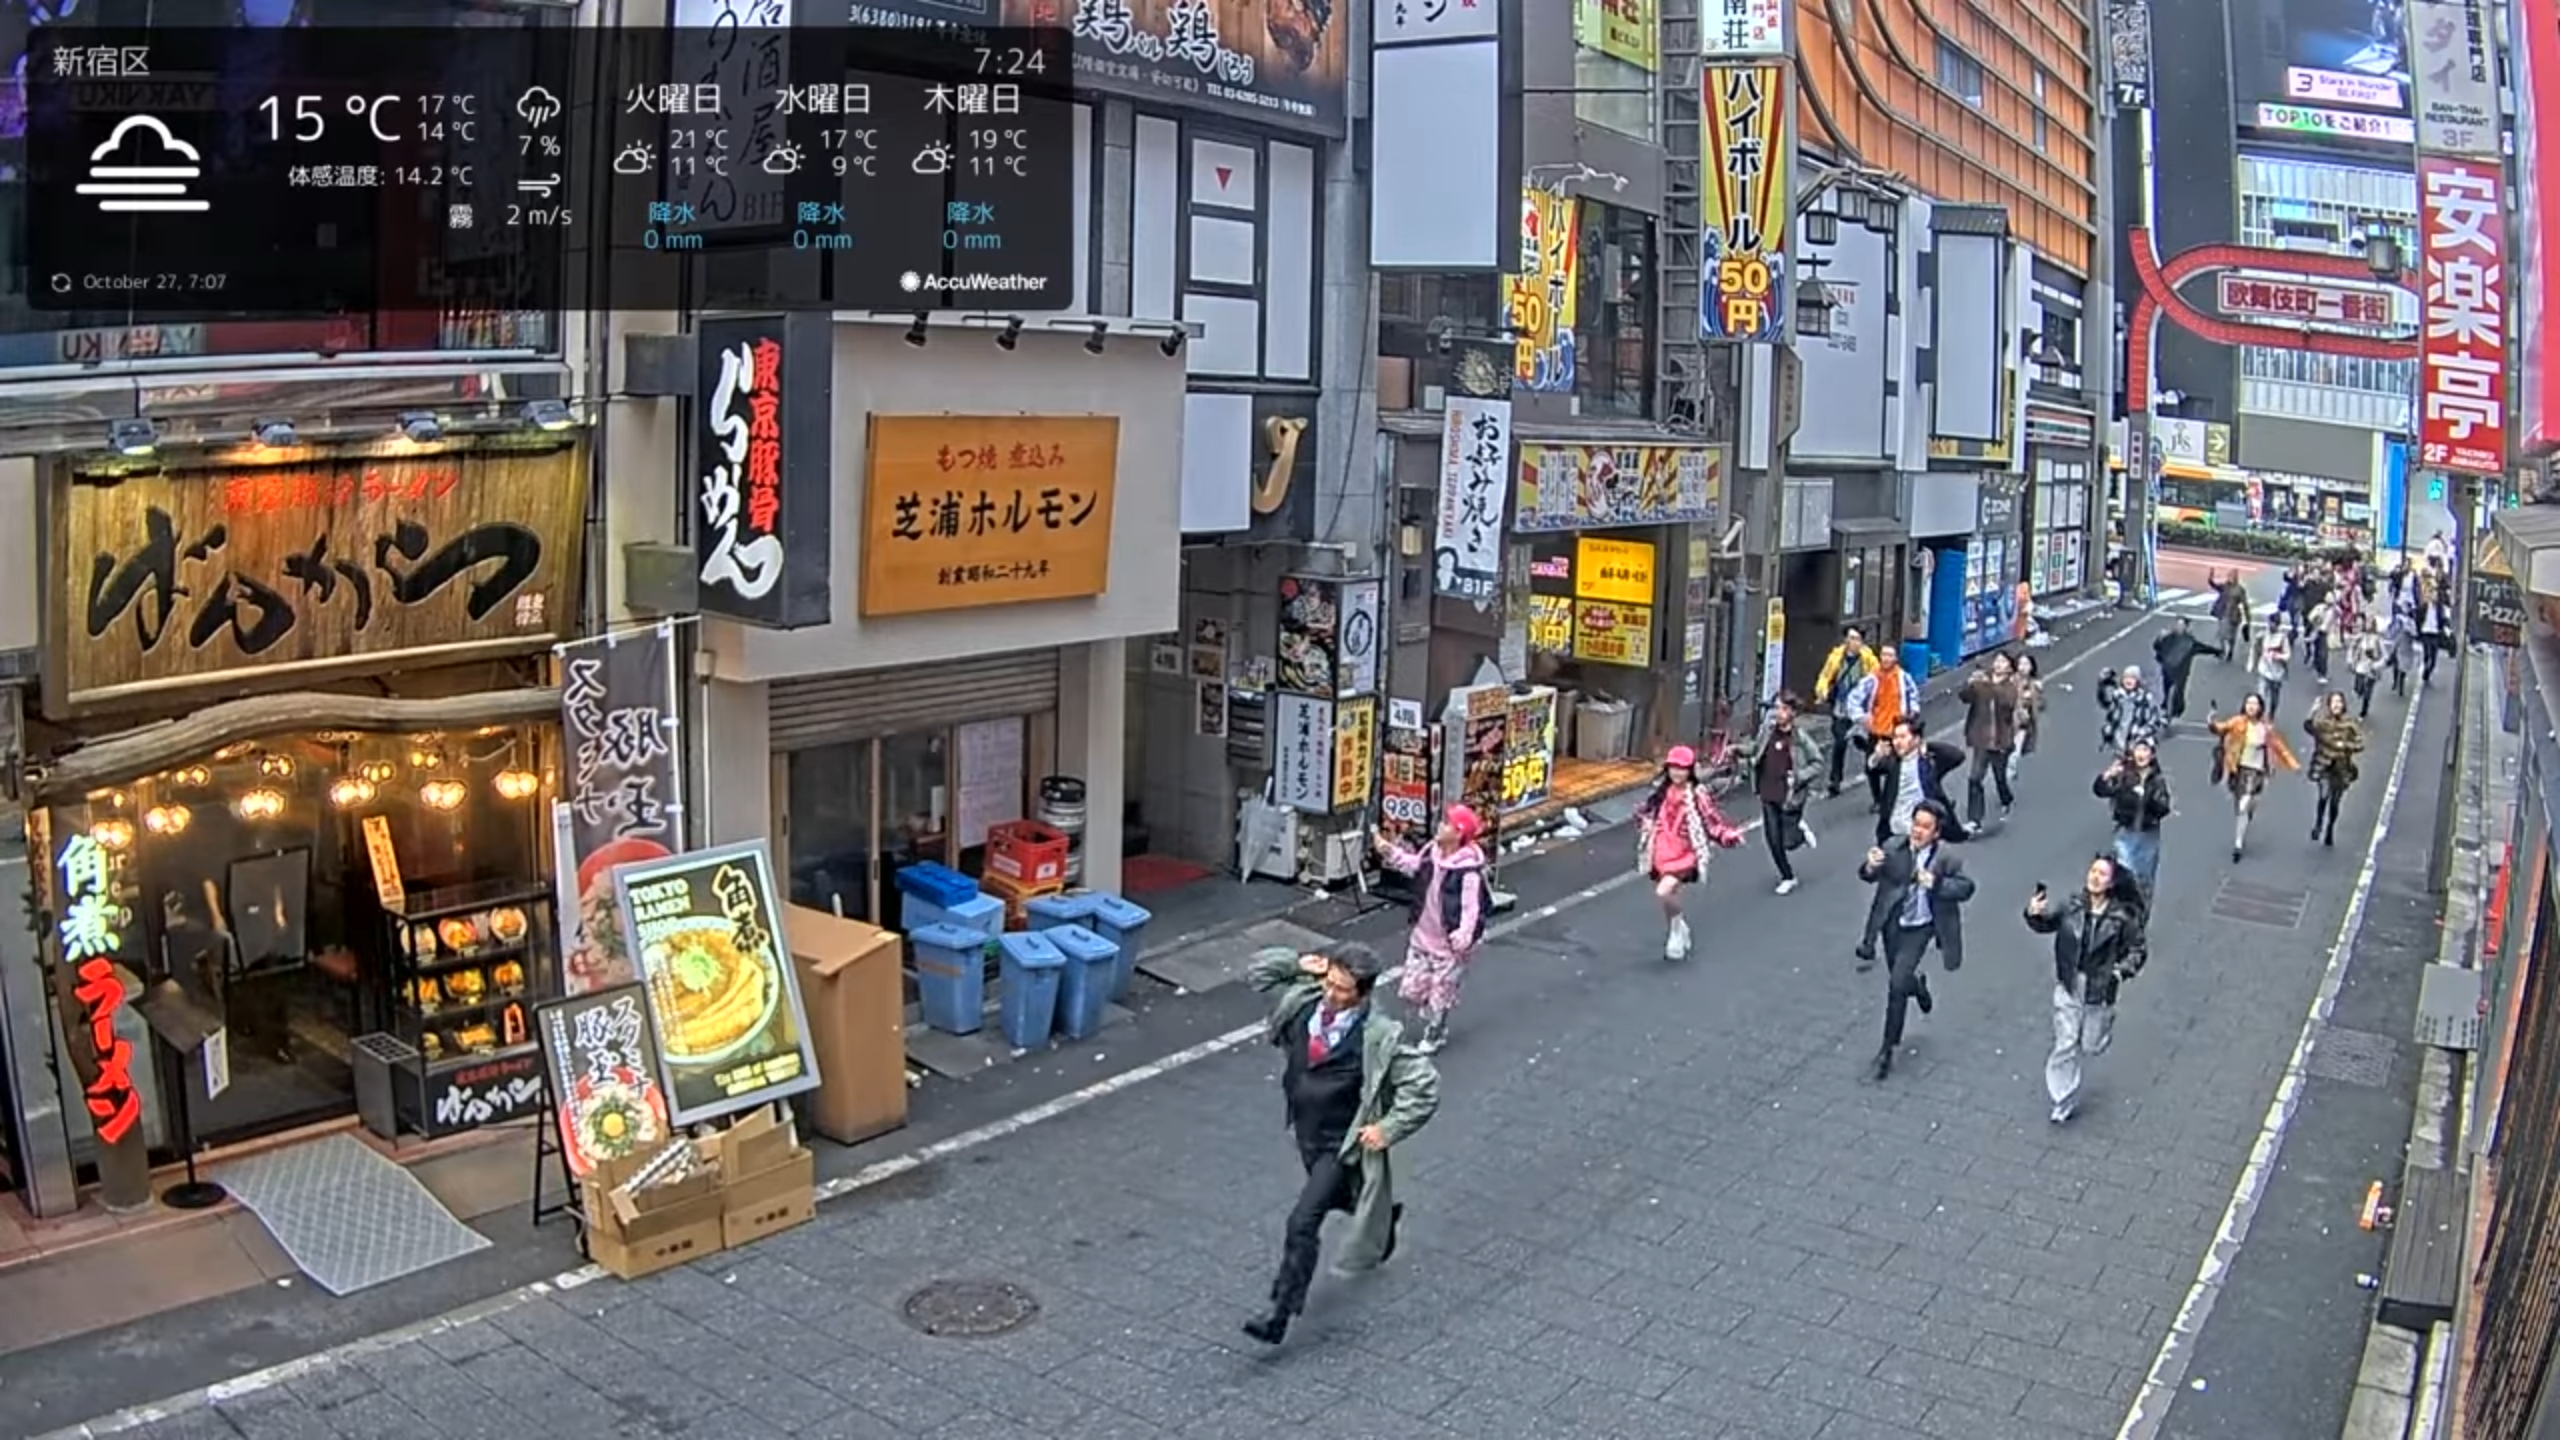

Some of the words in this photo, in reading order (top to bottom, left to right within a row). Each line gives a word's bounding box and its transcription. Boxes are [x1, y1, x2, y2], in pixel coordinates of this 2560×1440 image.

[2118, 84, 2146, 105] 7F
[2296, 73, 2313, 92] 3
[2424, 112, 2490, 127] RESTAURANT
[2442, 129, 2475, 148] 3F
[1727, 70, 1763, 252] ハイボール
[1719, 260, 1769, 295] 50
[1513, 293, 1542, 335] 50
[1726, 299, 1759, 334] 円
[2226, 280, 2387, 325] 歌舞伎町一番街
[2426, 168, 2499, 440] 安楽亭
[1515, 337, 1536, 379] 円
[748, 337, 782, 533] 東京豚骨
[2423, 442, 2449, 463] 2F
[936, 443, 998, 472] もつ焼
[1008, 441, 1065, 470] 煮込み
[1460, 411, 1503, 553] お好み焼き
[892, 486, 1098, 541] 芝浦ホルモン
[87, 504, 544, 656] ばんから
[1463, 578, 1494, 597] B1F
[630, 878, 690, 905] TOKYO
[635, 895, 692, 922] RAMEN
[712, 864, 770, 952] 角煮
